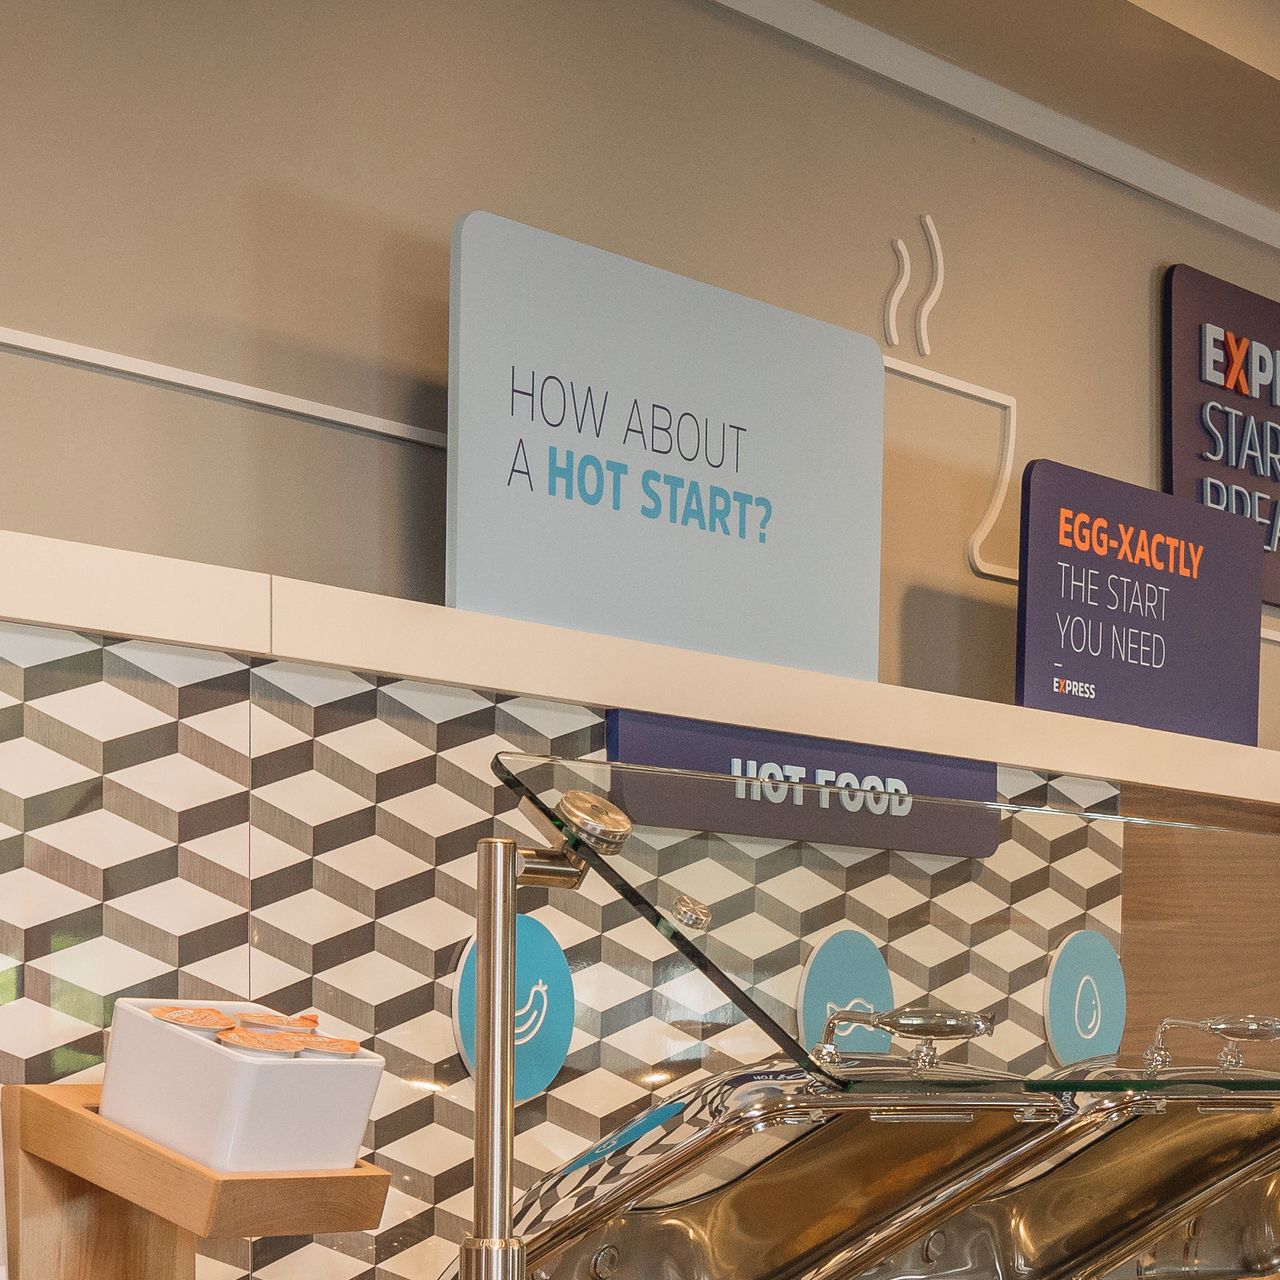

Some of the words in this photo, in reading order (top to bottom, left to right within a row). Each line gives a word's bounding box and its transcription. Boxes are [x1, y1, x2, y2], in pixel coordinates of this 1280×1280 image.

[510, 365, 609, 438] HOW
[622, 398, 748, 473] ABOUT
[507, 438, 534, 492] A
[547, 445, 629, 512] HOT
[640, 469, 773, 545] START?
[1058, 507, 1204, 580] EGG-XACTLY
[1057, 561, 1100, 606] THE
[1106, 574, 1170, 622] START
[1055, 612, 1103, 657] YOU
[1110, 624, 1166, 669] NEED
[1052, 676, 1097, 699] EXPRESS
[730, 757, 807, 806] HOT
[814, 768, 913, 818] FOOD
